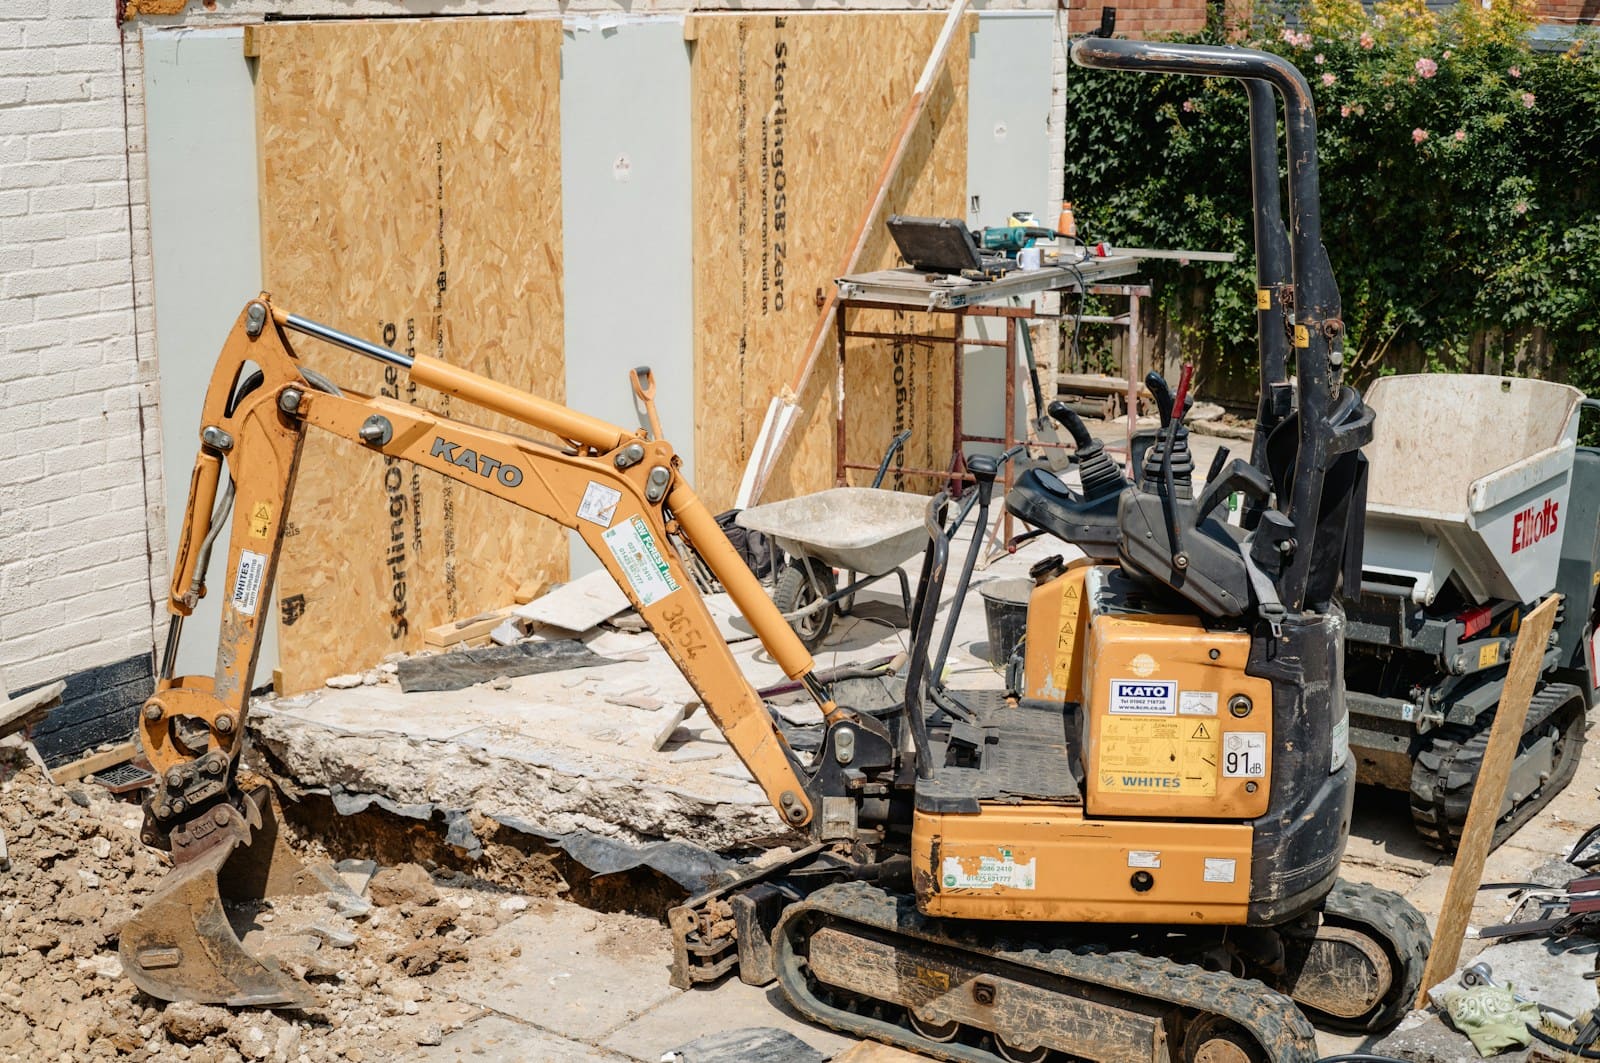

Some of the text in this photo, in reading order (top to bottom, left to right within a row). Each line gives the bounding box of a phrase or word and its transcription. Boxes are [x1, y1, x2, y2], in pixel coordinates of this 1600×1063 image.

[771, 42, 787, 312] SterlingOSB Zero
[761, 297, 768, 316] on
[381, 323, 399, 400] Zeo
[430, 436, 524, 488] KATO
[1511, 498, 1559, 554] Elliotts
[630, 515, 649, 537] EW
[642, 535, 668, 570] FOREST
[661, 568, 679, 591] HIRE
[235, 562, 250, 601] WHITES
[662, 603, 707, 660] 3654
[1121, 686, 1165, 697] KATO
[1122, 776, 1181, 788] WHITES
[1227, 752, 1262, 774] 91 dB
